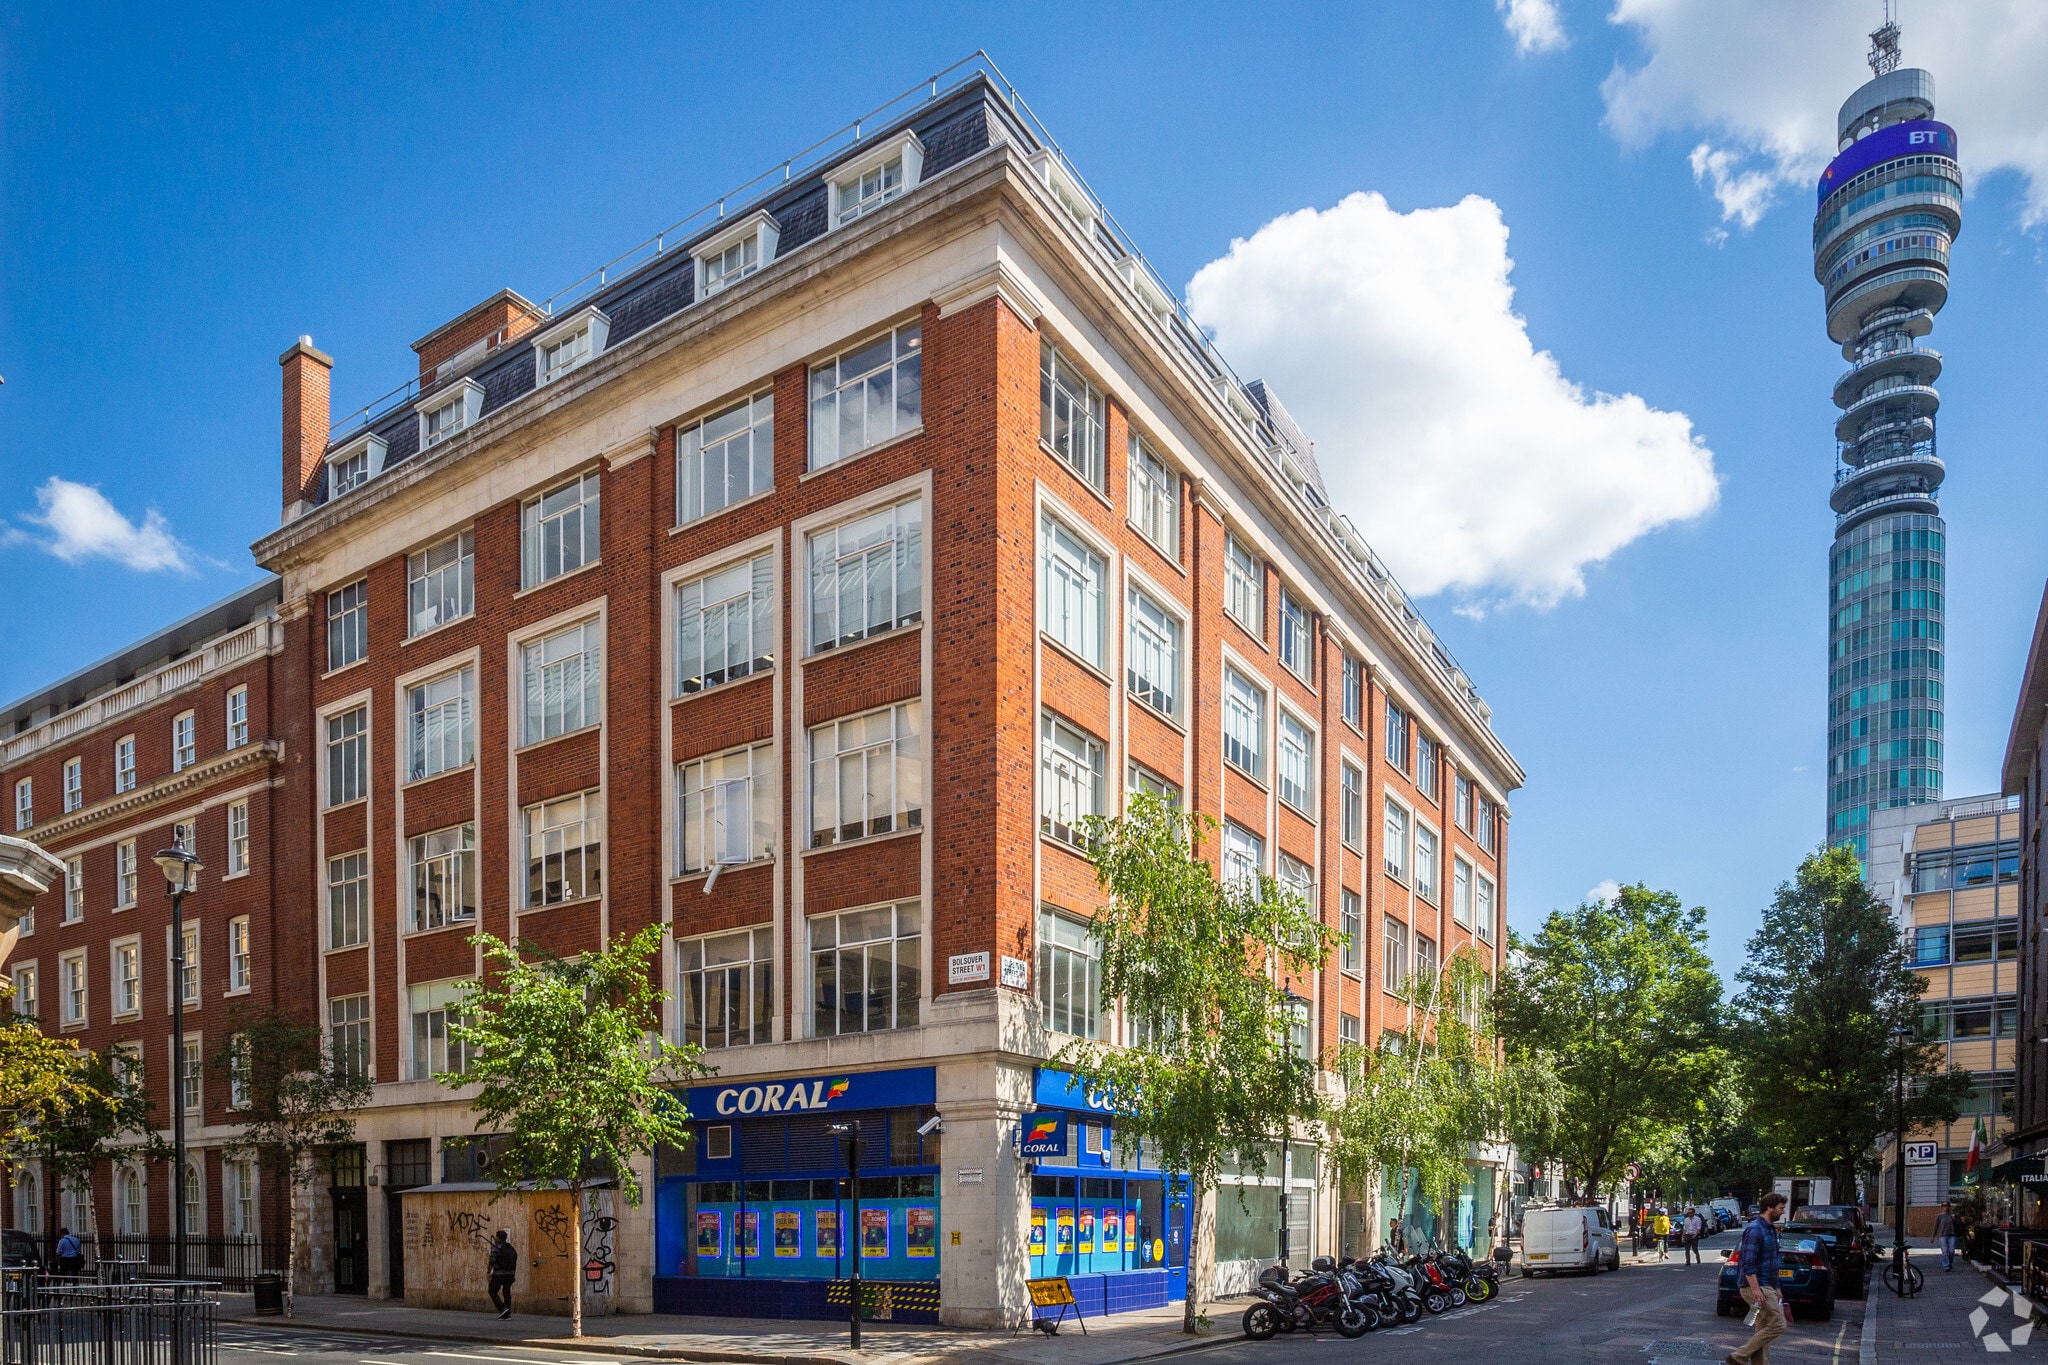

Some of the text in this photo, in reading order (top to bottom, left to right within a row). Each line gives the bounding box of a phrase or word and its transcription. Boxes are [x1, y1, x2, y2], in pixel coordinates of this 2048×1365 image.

[1909, 130, 1938, 145] BT
[952, 955, 983, 967] BOLSOVER
[952, 963, 986, 975] STREET W1
[716, 1080, 829, 1115] CORAL
[1023, 1143, 1059, 1153] CORAL
[1921, 1146, 1931, 1157] P
[2021, 1174, 2048, 1182] ITALIA
